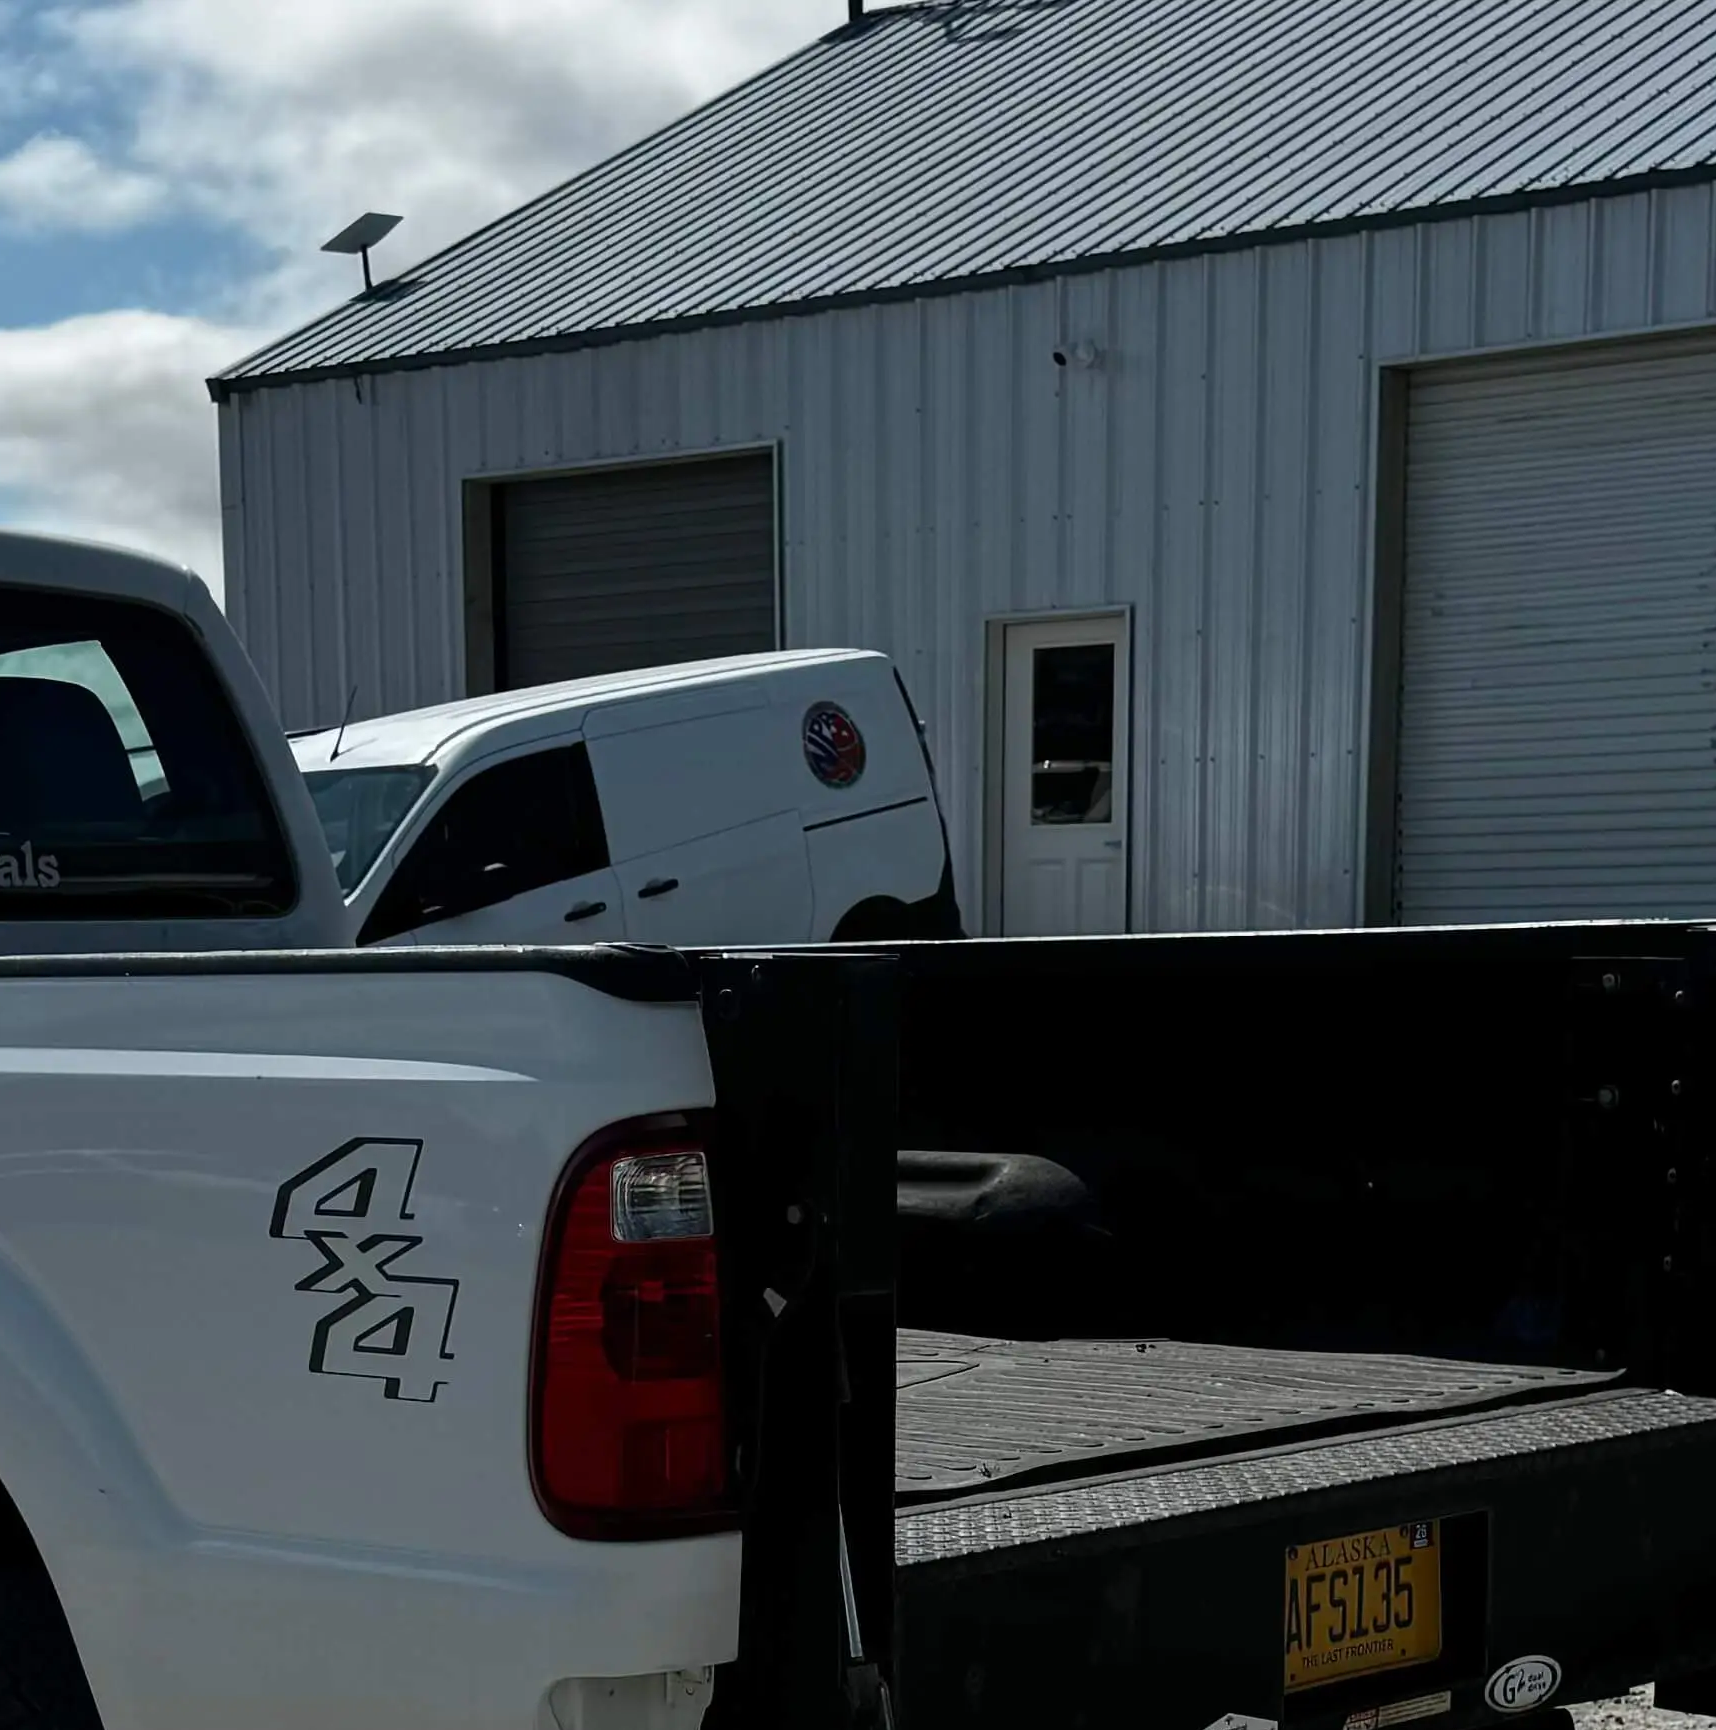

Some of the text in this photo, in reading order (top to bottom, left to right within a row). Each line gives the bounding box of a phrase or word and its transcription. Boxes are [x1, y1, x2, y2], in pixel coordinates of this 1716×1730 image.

[1305, 1532, 1391, 1571] ALASKA
[1286, 1556, 1413, 1654] AFS135
[1303, 1639, 1394, 1668] THE LAST FRONTIER
